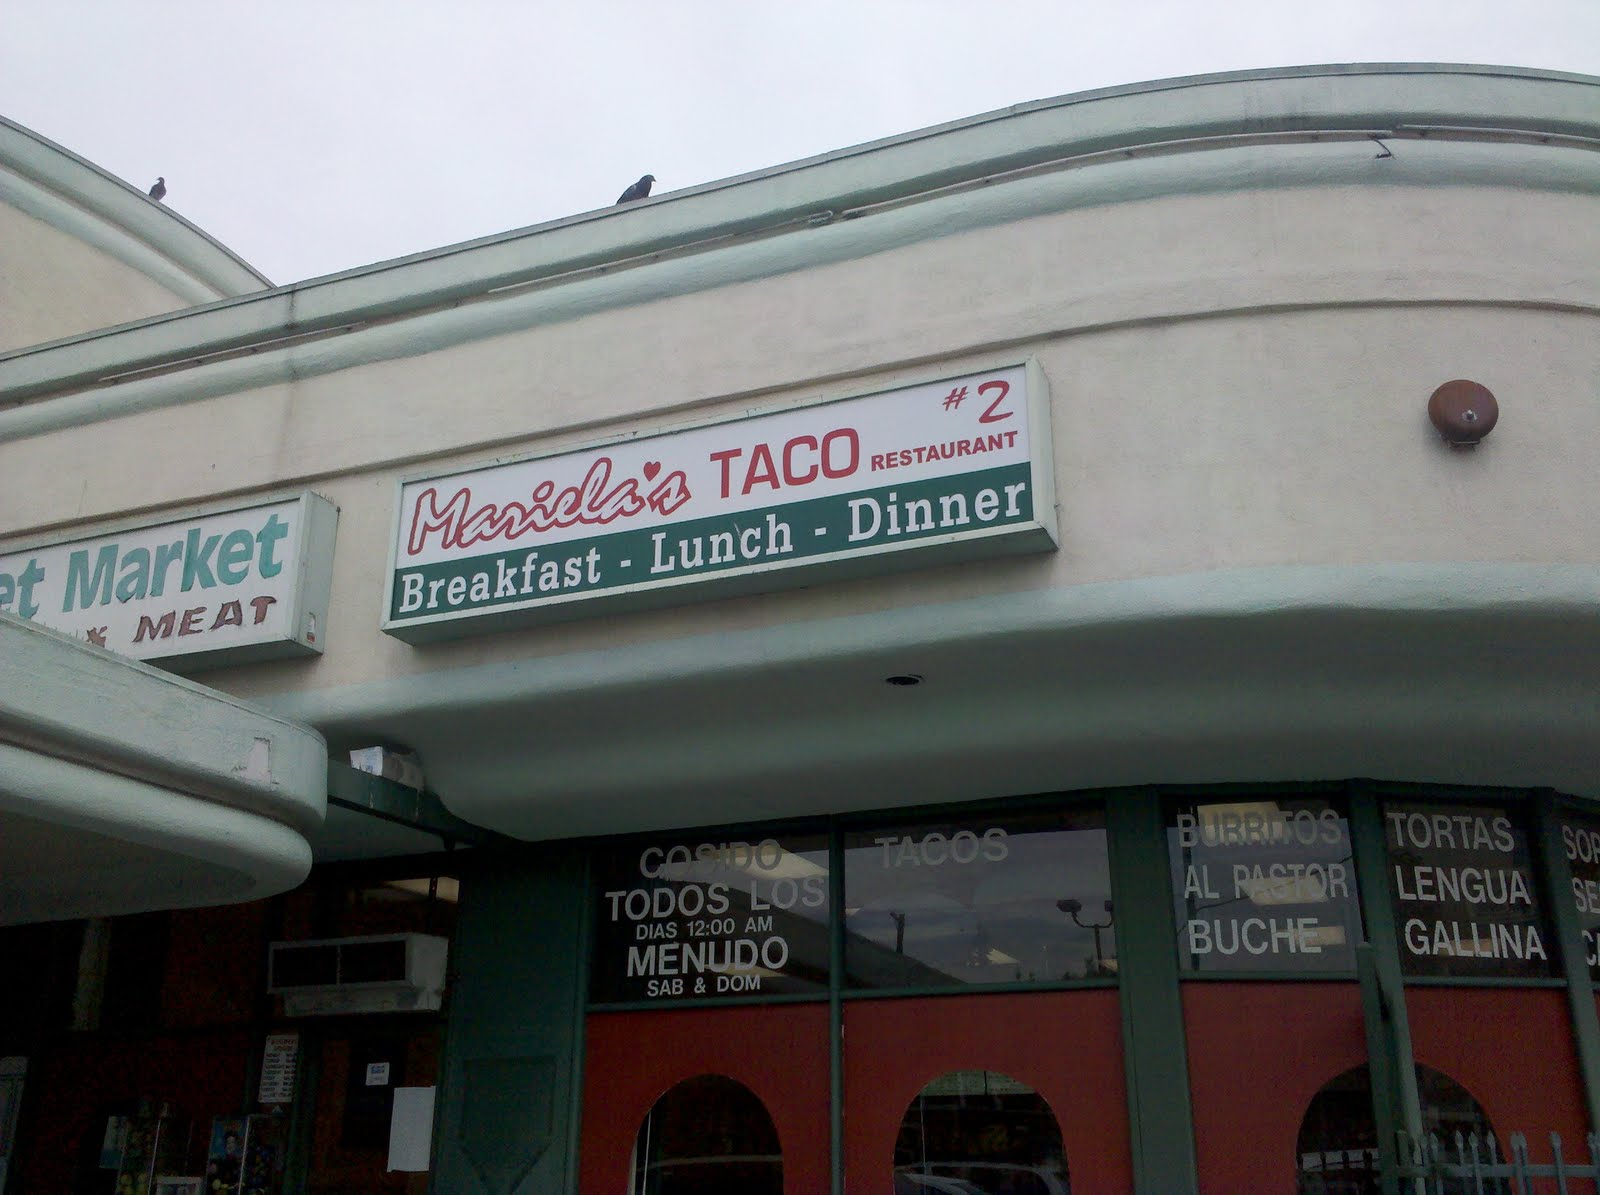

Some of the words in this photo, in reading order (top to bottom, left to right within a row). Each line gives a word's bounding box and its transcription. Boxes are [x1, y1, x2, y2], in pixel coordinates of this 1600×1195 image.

[710, 427, 860, 499] TACO
[871, 431, 1018, 472] RESTAURANT
[62, 513, 289, 612] Market
[399, 553, 602, 613] Breakfast
[651, 513, 792, 574] Lunch
[848, 480, 1026, 542] Dinner
[132, 595, 277, 643] MEAT
[874, 828, 1009, 868] TACOS
[1177, 809, 1342, 848] BURRITOS
[1387, 811, 1515, 853] TORTAS
[640, 839, 783, 879] COSIDO
[605, 882, 730, 921] TODOS
[750, 876, 825, 911] LOS
[1184, 866, 1220, 899] AL
[1233, 864, 1349, 899] PASTOR
[1394, 865, 1531, 905] LENGUA
[1572, 876, 1600, 914] SE
[636, 922, 677, 941] DIAS
[687, 918, 735, 937] 12:00
[745, 916, 773, 933] AM
[1187, 917, 1322, 955] BUCHE
[1405, 919, 1547, 961] GALLINA
[627, 936, 789, 977] MENUDO
[647, 979, 684, 997] SAB
[694, 978, 706, 994] &
[717, 975, 761, 993] DOM
